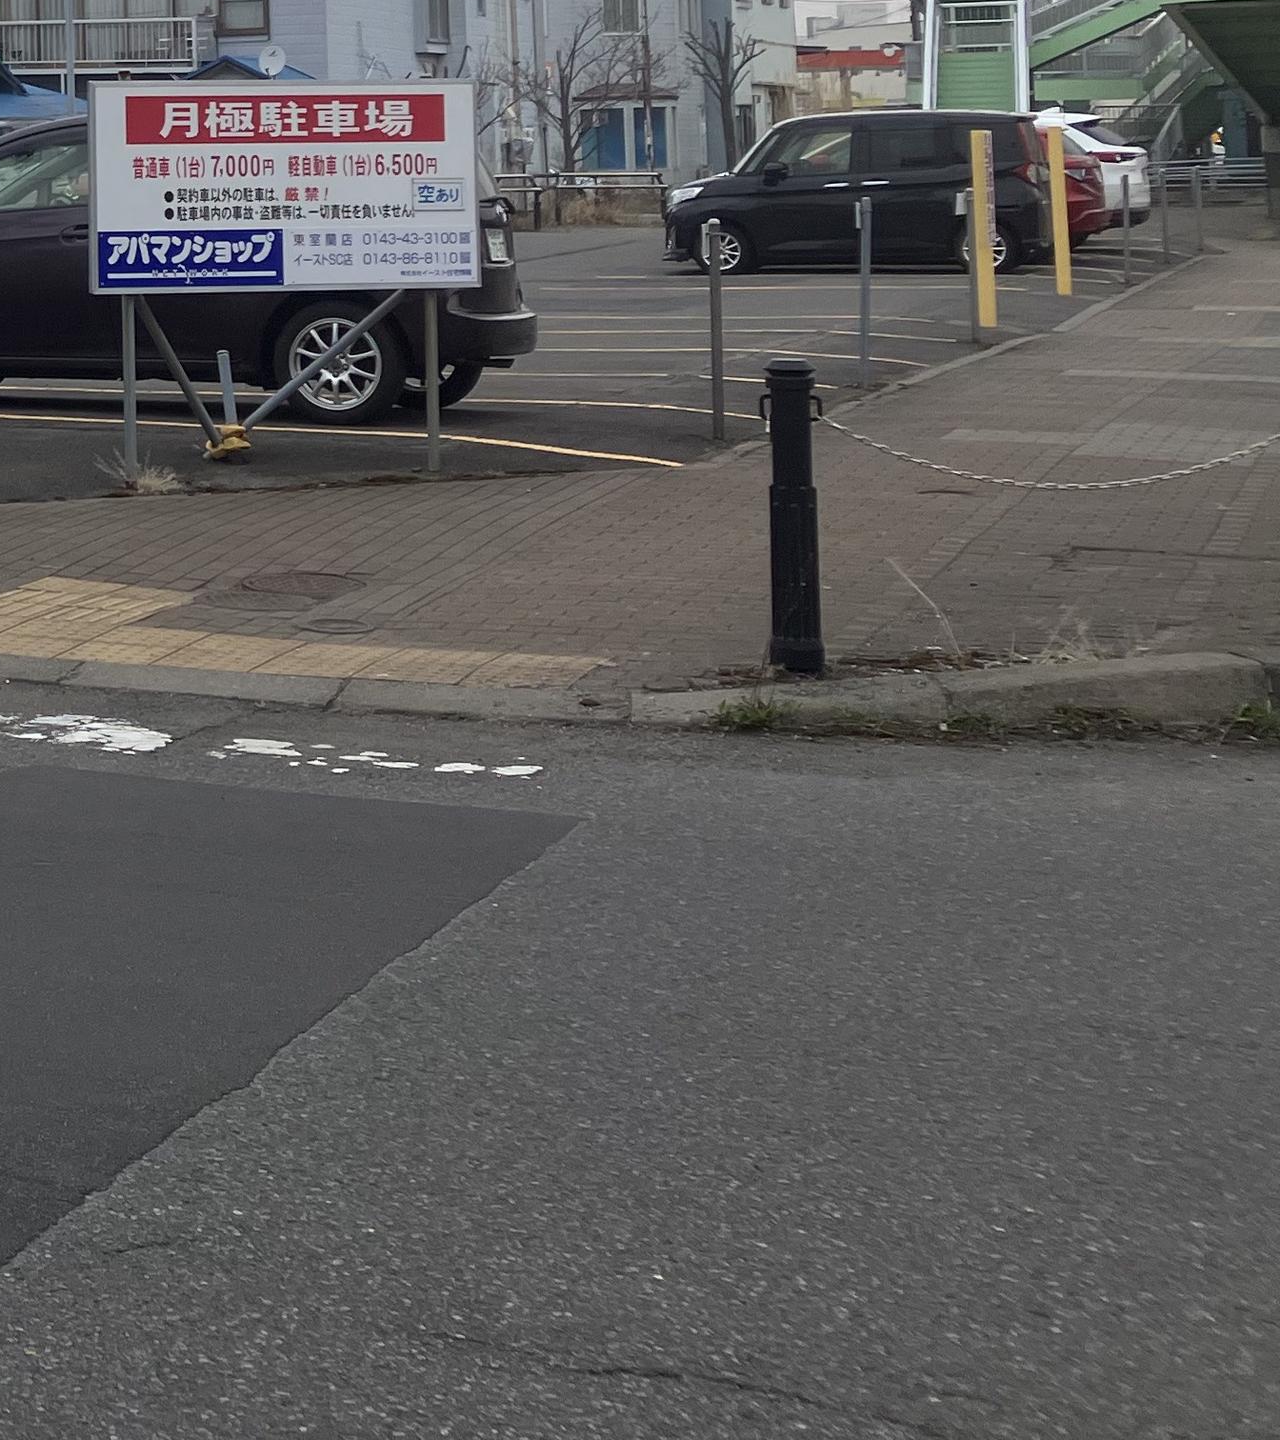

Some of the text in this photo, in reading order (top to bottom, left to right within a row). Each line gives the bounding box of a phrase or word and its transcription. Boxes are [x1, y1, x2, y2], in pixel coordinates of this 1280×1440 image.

[159, 100, 414, 139] 月極駐車場
[418, 184, 459, 203] 空あり
[107, 231, 276, 265] アパマンショップ
